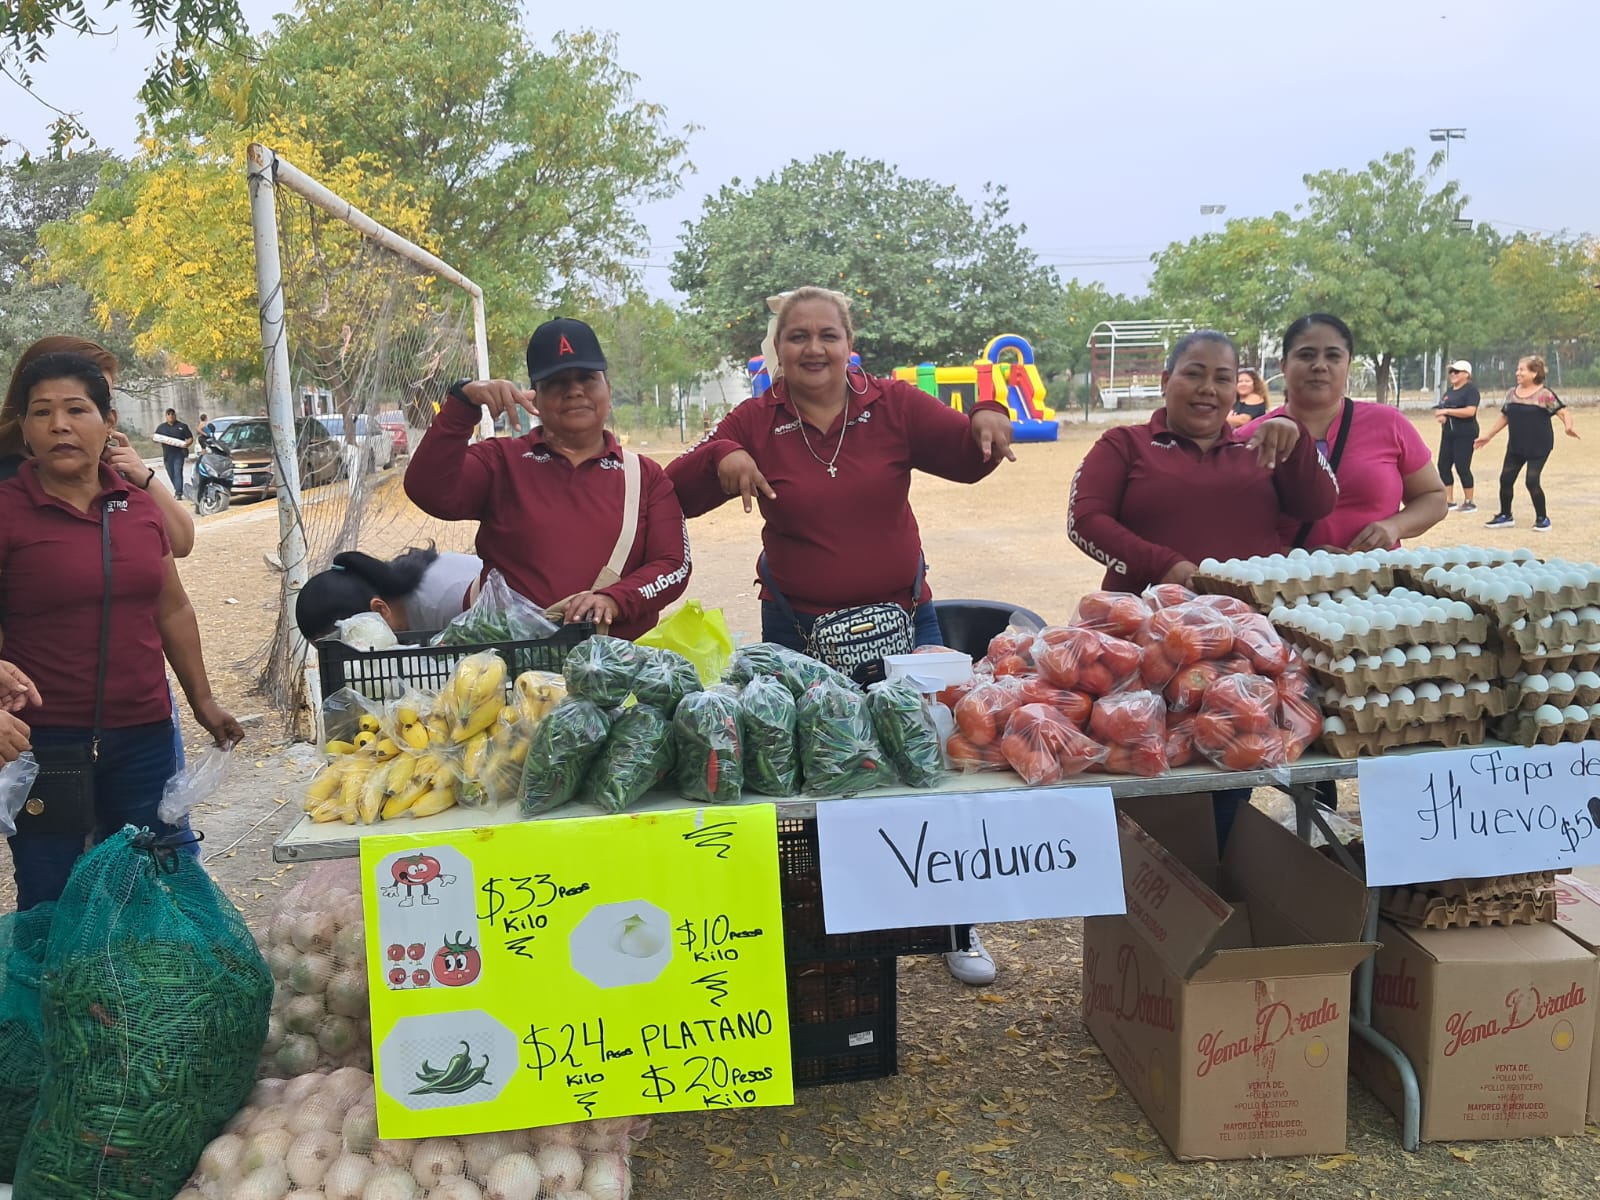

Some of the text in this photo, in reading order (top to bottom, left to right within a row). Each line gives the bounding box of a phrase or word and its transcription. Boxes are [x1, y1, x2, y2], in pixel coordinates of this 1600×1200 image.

[559, 334, 574, 356] A
[1570, 746, 1600, 776] de
[878, 818, 1076, 888] Verduras
[476, 874, 557, 926] $33
[1131, 861, 1171, 910] TAPA
[676, 914, 729, 952] $10
[641, 1009, 772, 1056] PLATANO
[1443, 981, 1587, 1057] Yema Dorada
[523, 1017, 605, 1080] $24
[1197, 1029, 1252, 1077] Yema
[1495, 1064, 1517, 1072] VENTA
[731, 1066, 773, 1086] Pesos
[1248, 1081, 1271, 1090] VENTA
[1518, 1073, 1534, 1081] VIVO
